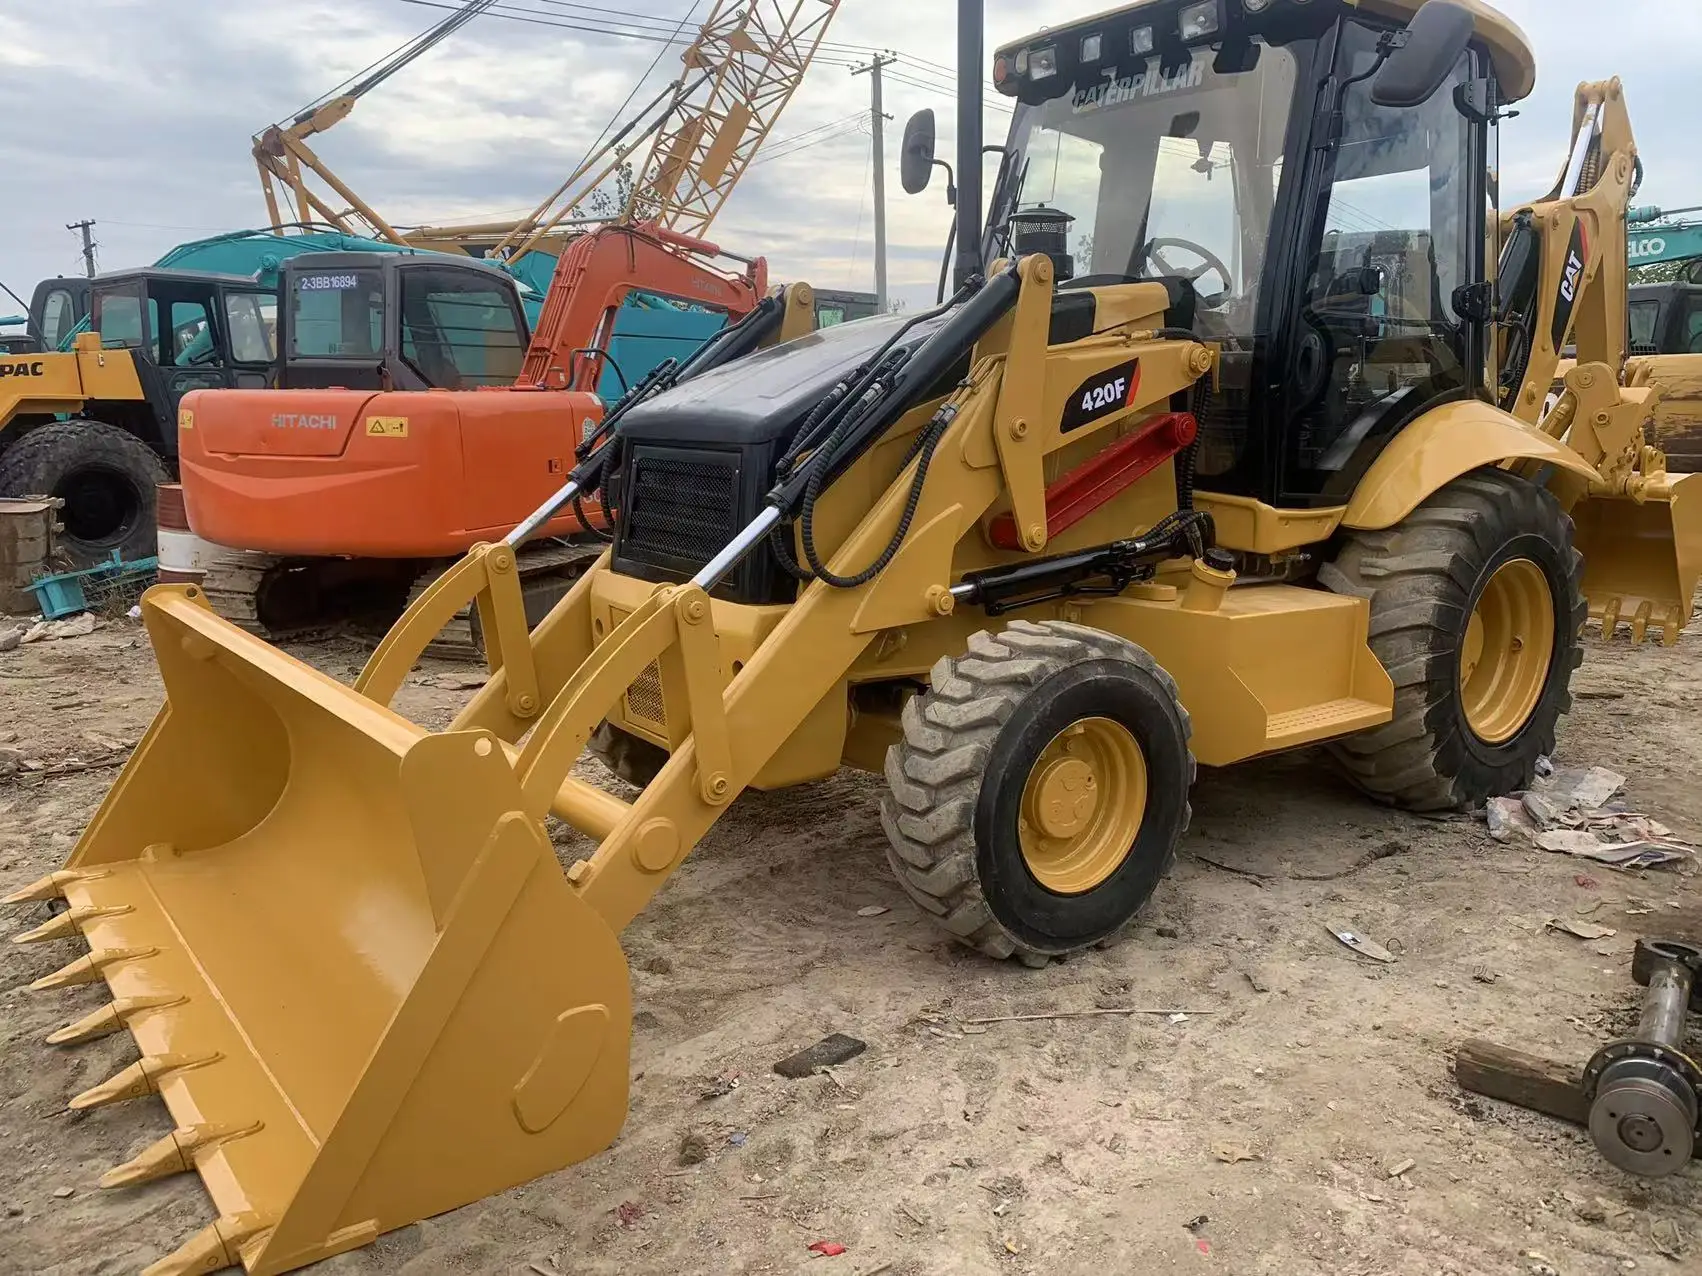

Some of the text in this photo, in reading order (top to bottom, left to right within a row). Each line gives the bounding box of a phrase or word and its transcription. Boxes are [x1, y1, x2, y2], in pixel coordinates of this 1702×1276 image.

[1072, 59, 1206, 114] CATERPILLAR
[301, 275, 357, 290] 2-3BB16894
[1560, 249, 1583, 302] CAT
[0, 362, 43, 377] PAC
[1082, 377, 1125, 411] 420F
[271, 414, 337, 430] HITACHI
